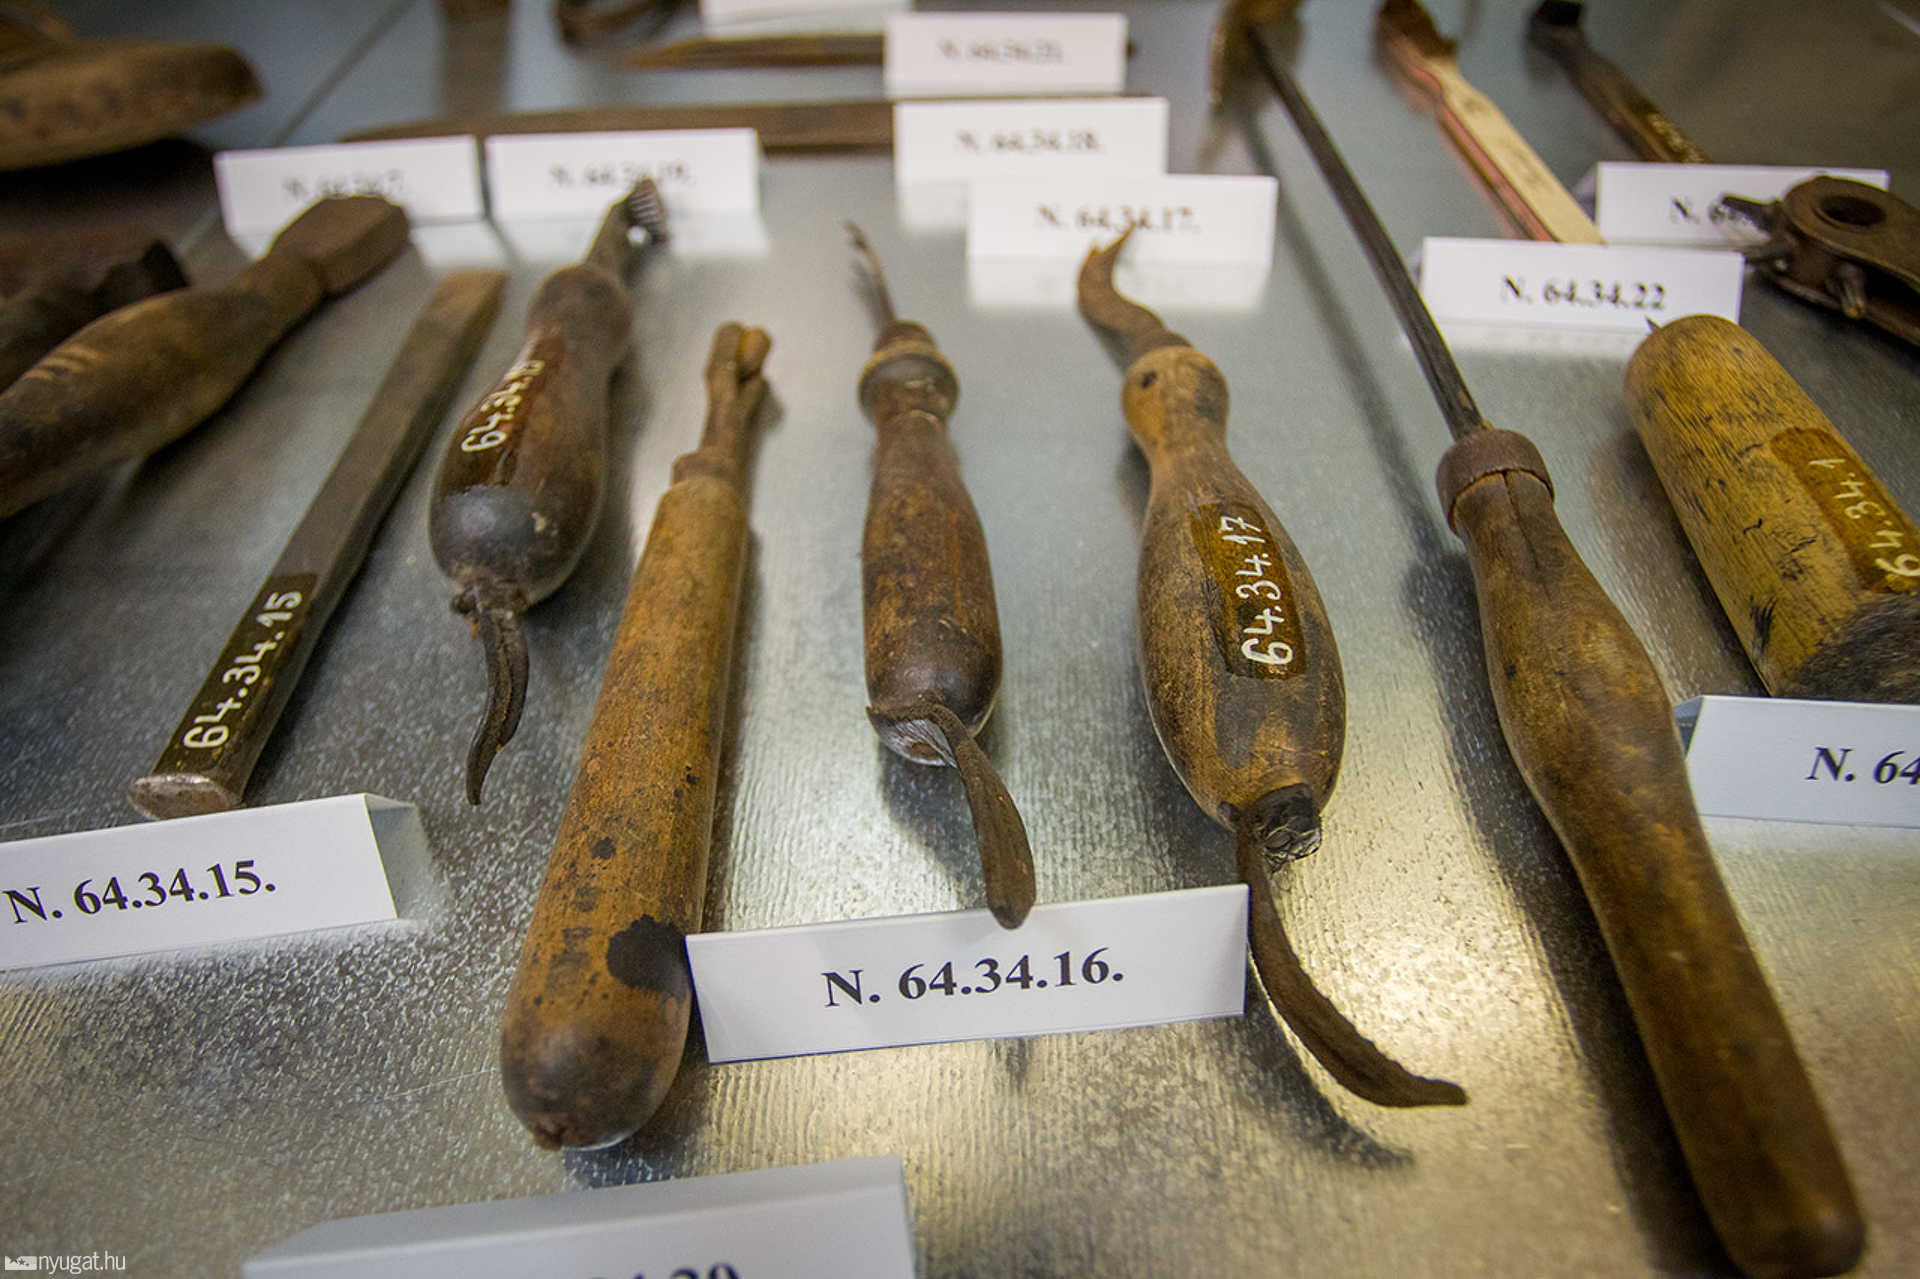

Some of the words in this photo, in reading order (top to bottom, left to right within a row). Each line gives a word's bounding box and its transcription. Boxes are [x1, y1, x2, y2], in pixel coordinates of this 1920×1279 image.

[1037, 204, 1071, 232] N.
[1501, 274, 1532, 304] N.
[1218, 515, 1294, 665] 64.34.17
[183, 590, 302, 749] 64.34.15
[1804, 746, 1856, 782] N.
[2, 886, 62, 925] N.
[73, 859, 277, 915] 64.34.15.
[821, 968, 881, 1008] N.
[898, 947, 1125, 1001] 64.34.16.
